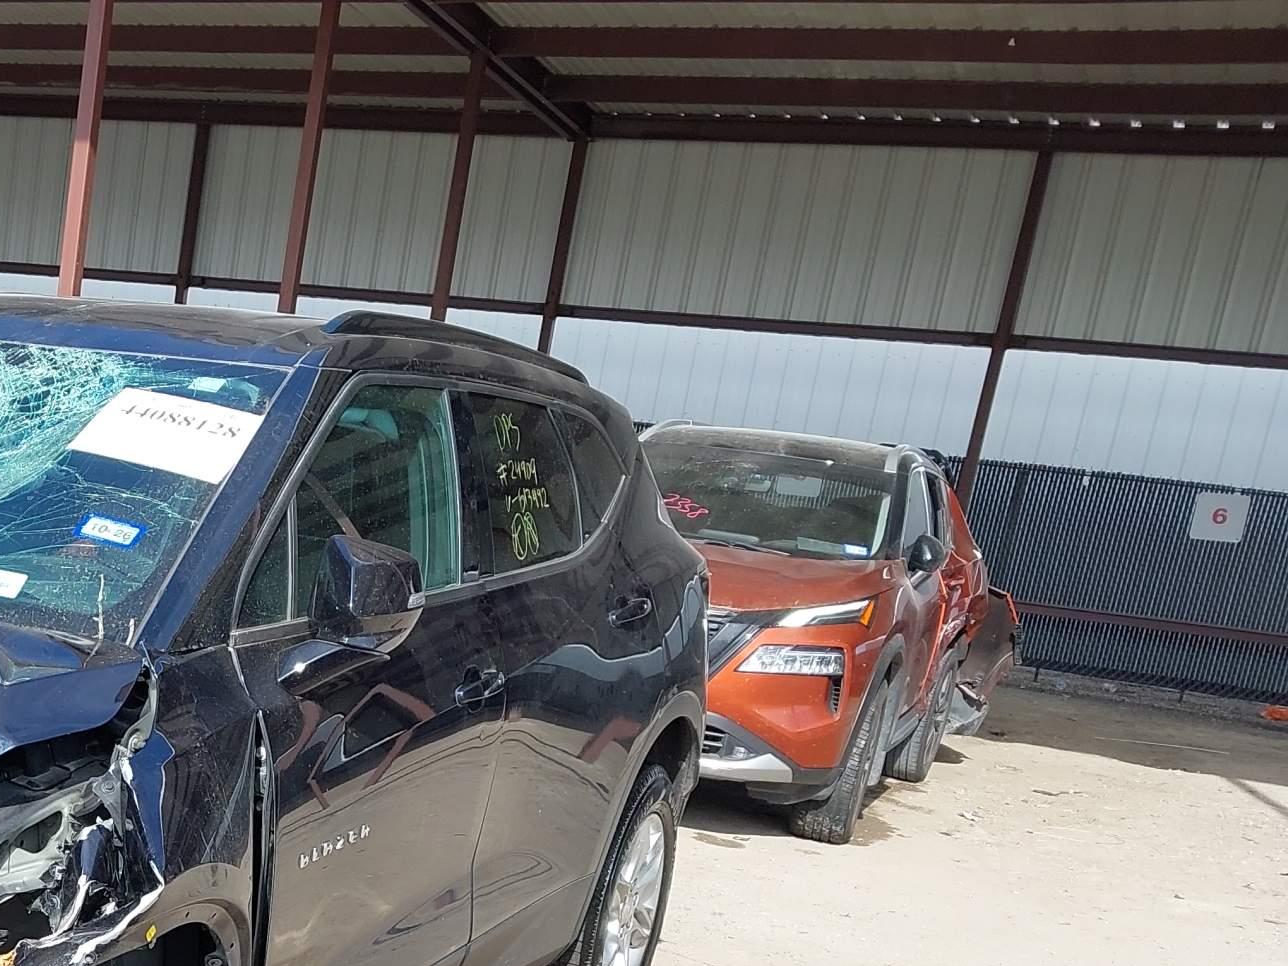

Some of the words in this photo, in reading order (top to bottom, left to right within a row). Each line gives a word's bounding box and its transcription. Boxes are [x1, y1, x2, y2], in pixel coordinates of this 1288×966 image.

[120, 404, 241, 438] 44088128
[1212, 507, 1228, 525] 6
[298, 824, 370, 868] BLAZER
